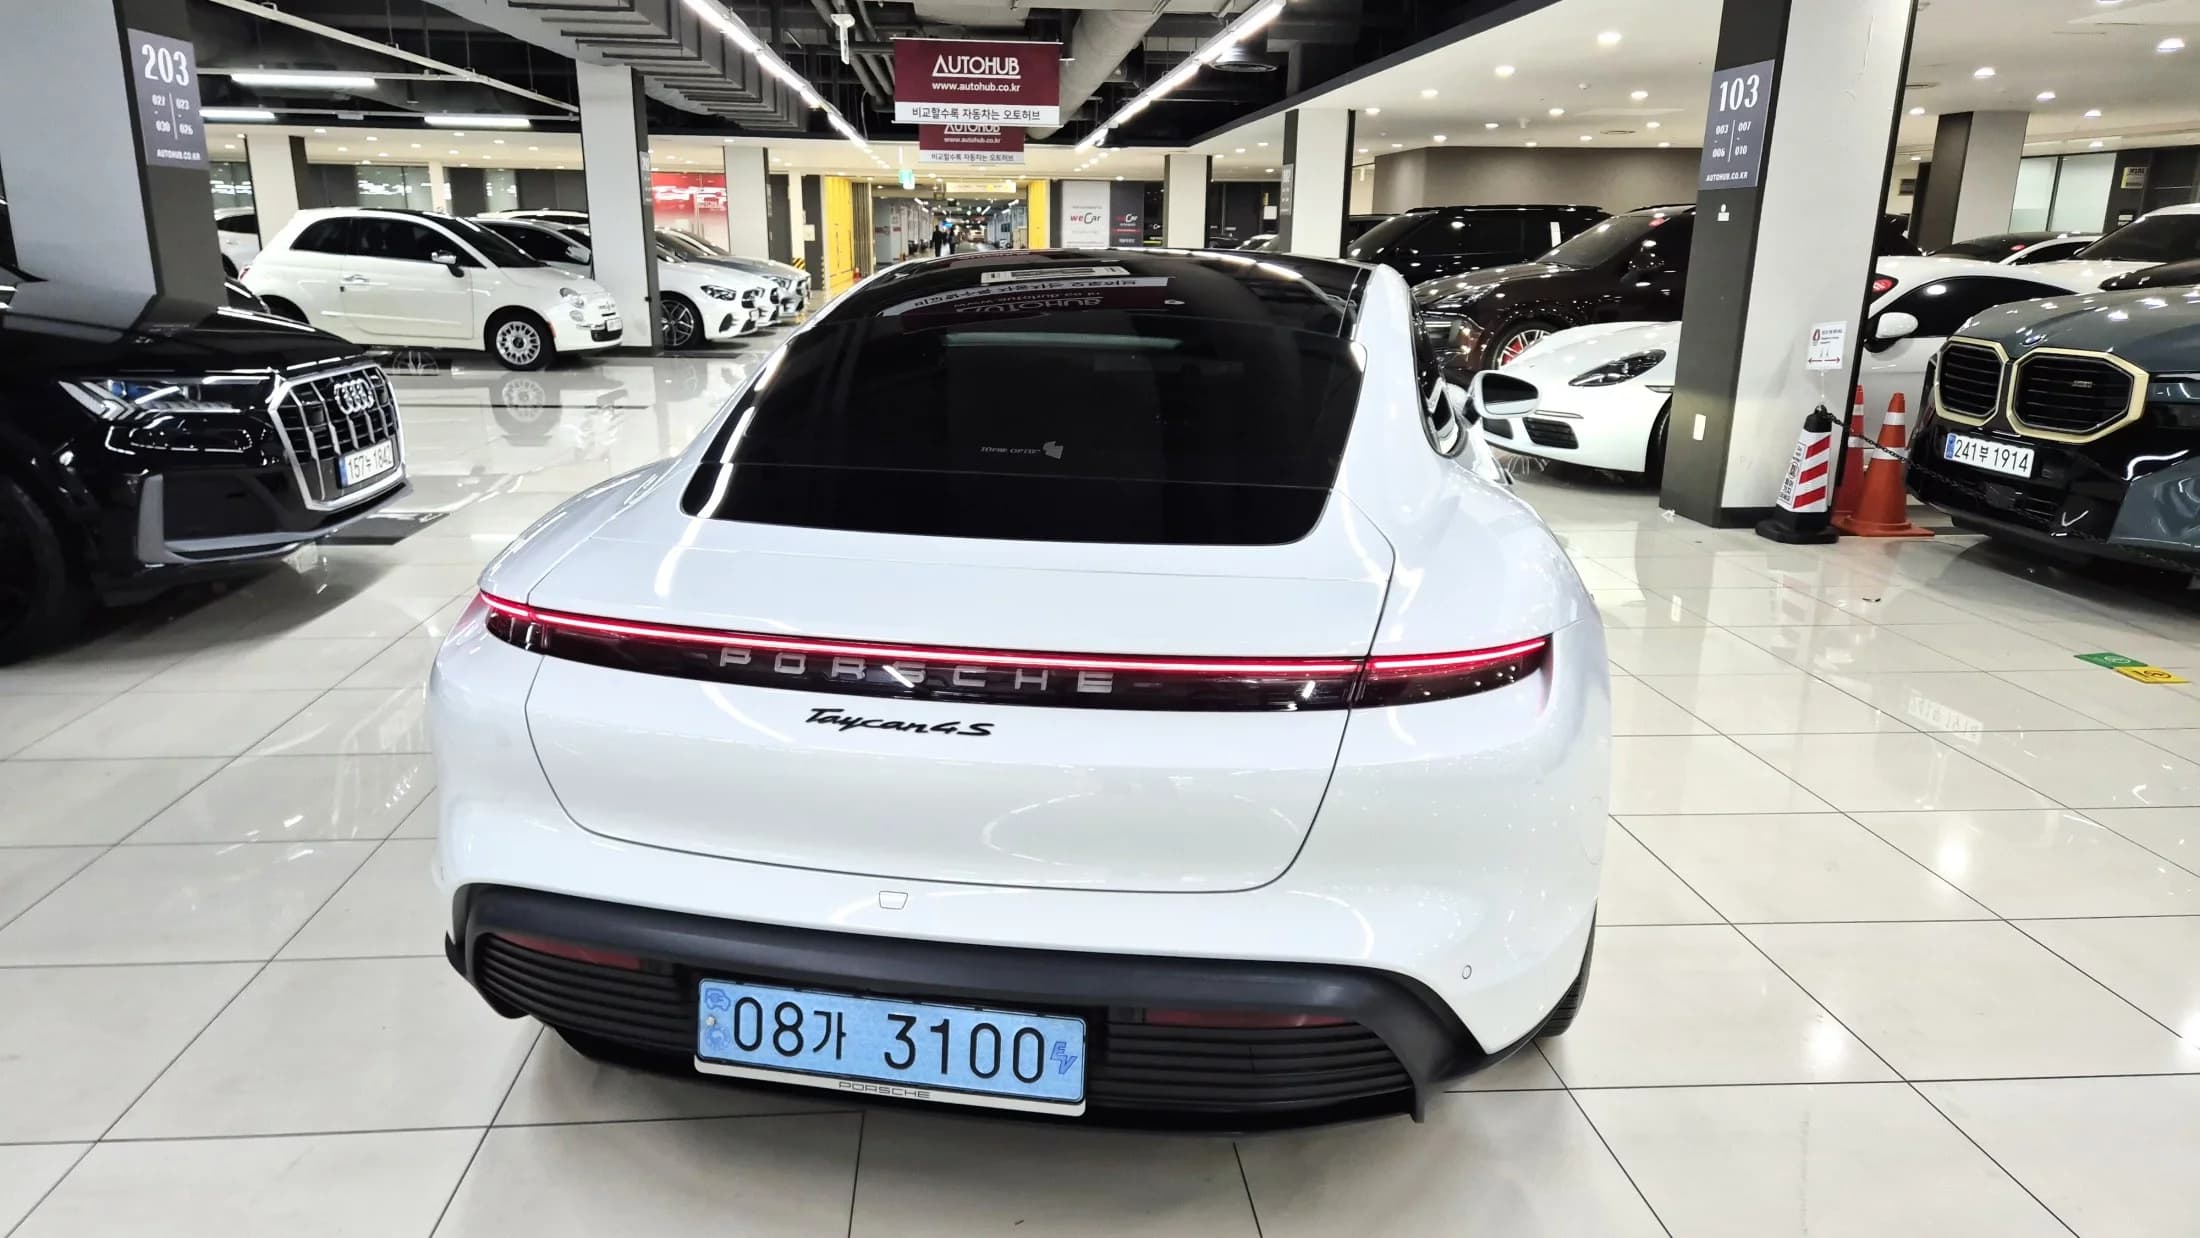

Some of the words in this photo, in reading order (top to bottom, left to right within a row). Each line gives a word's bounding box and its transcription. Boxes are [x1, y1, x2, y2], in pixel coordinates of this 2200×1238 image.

[141, 44, 189, 87] 203
[932, 54, 1021, 79] AUTOHUB
[932, 82, 1021, 93] www.autohub.co.kr
[1719, 74, 1760, 112] 103
[912, 107, 959, 119] 비교할수록
[962, 108, 1000, 121] 자동차는
[1003, 110, 1041, 121] 오토허브
[1716, 124, 1729, 136] 003
[1738, 121, 1752, 133] 007
[1712, 148, 1726, 159] 006
[1735, 144, 1748, 157] 010
[1706, 171, 1748, 182] AUTOHUB.CO.KR
[1954, 439, 1989, 463] 241부
[1994, 447, 2029, 473] 1914
[719, 646, 1114, 694] PORSCHE
[733, 996, 847, 1061] 08가
[883, 1012, 1045, 1085] 3100
[838, 1080, 931, 1100] PORSCHE
